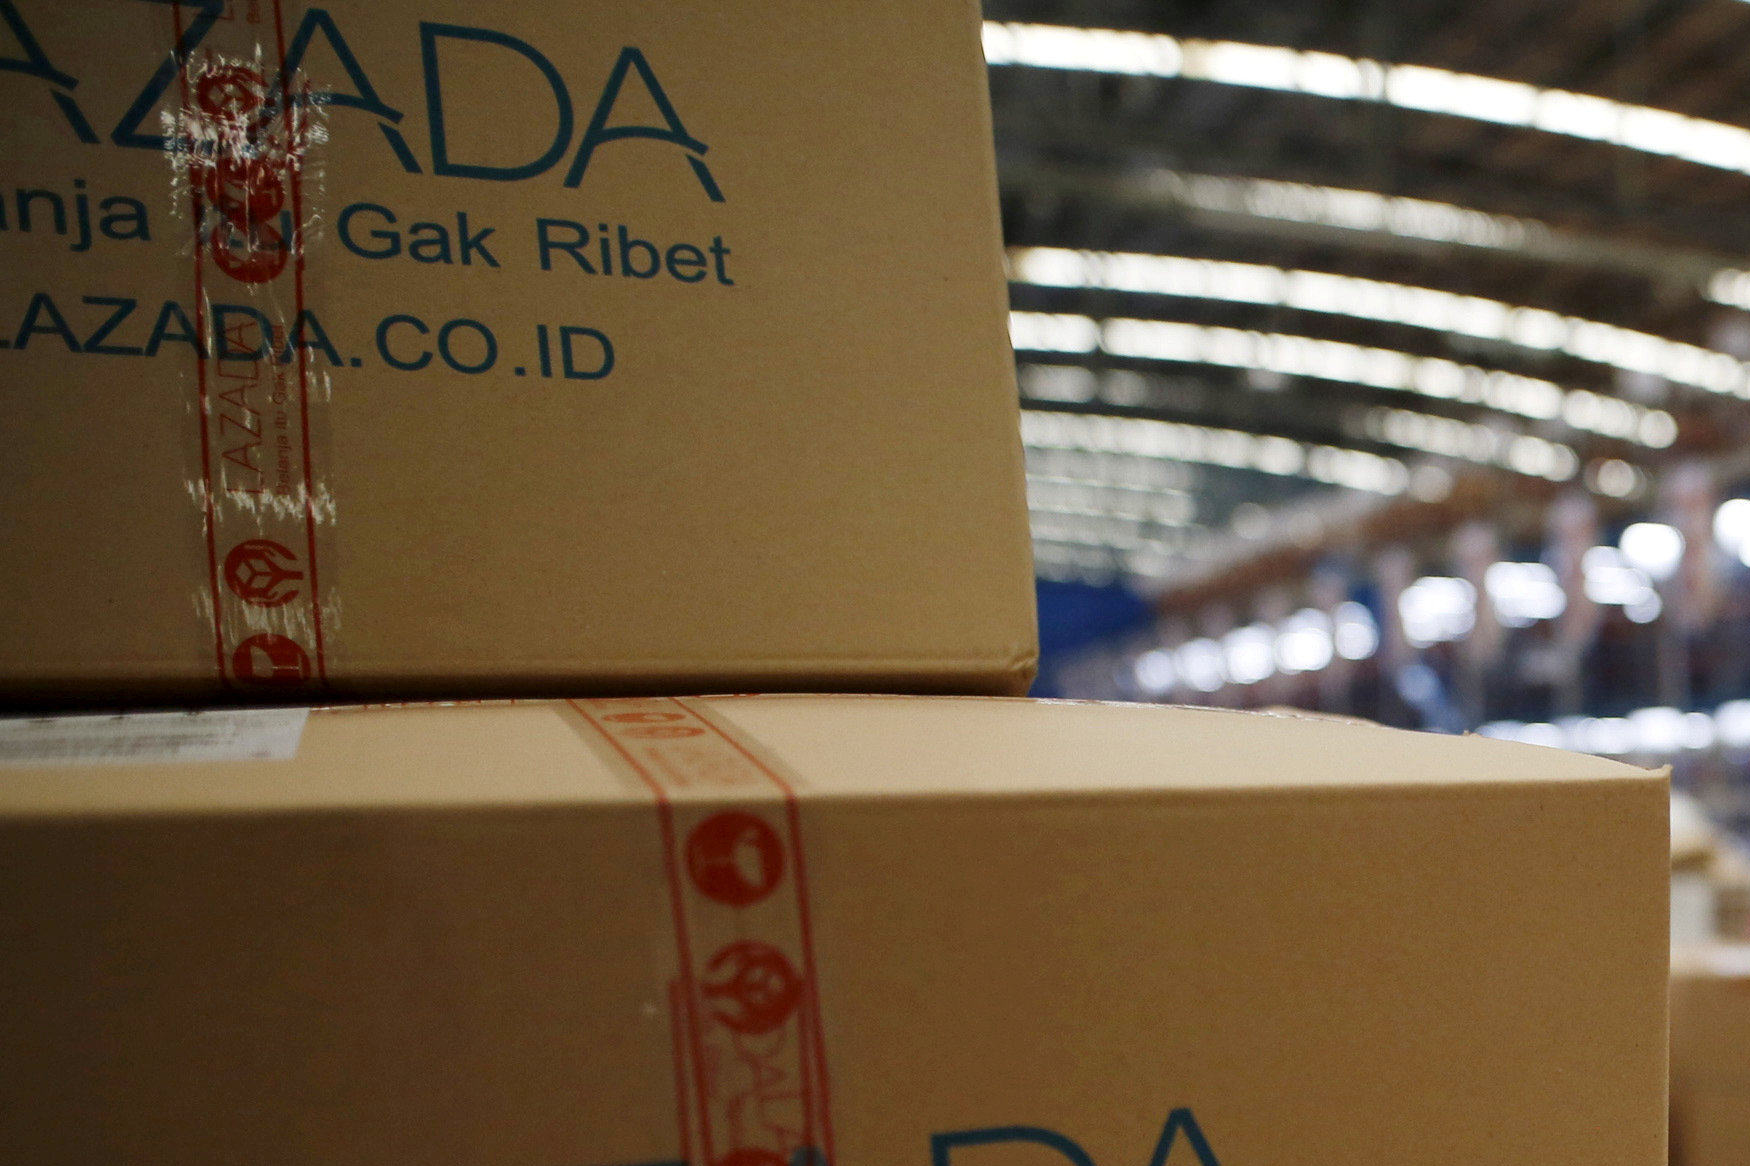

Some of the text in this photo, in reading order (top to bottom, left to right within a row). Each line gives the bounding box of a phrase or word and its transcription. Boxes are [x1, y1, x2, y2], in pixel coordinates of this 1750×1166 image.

[0, 179, 152, 253] nja
[336, 202, 501, 267] Gak
[535, 217, 736, 287] Ribet
[0, 293, 617, 381] AZADA.CO.ID
